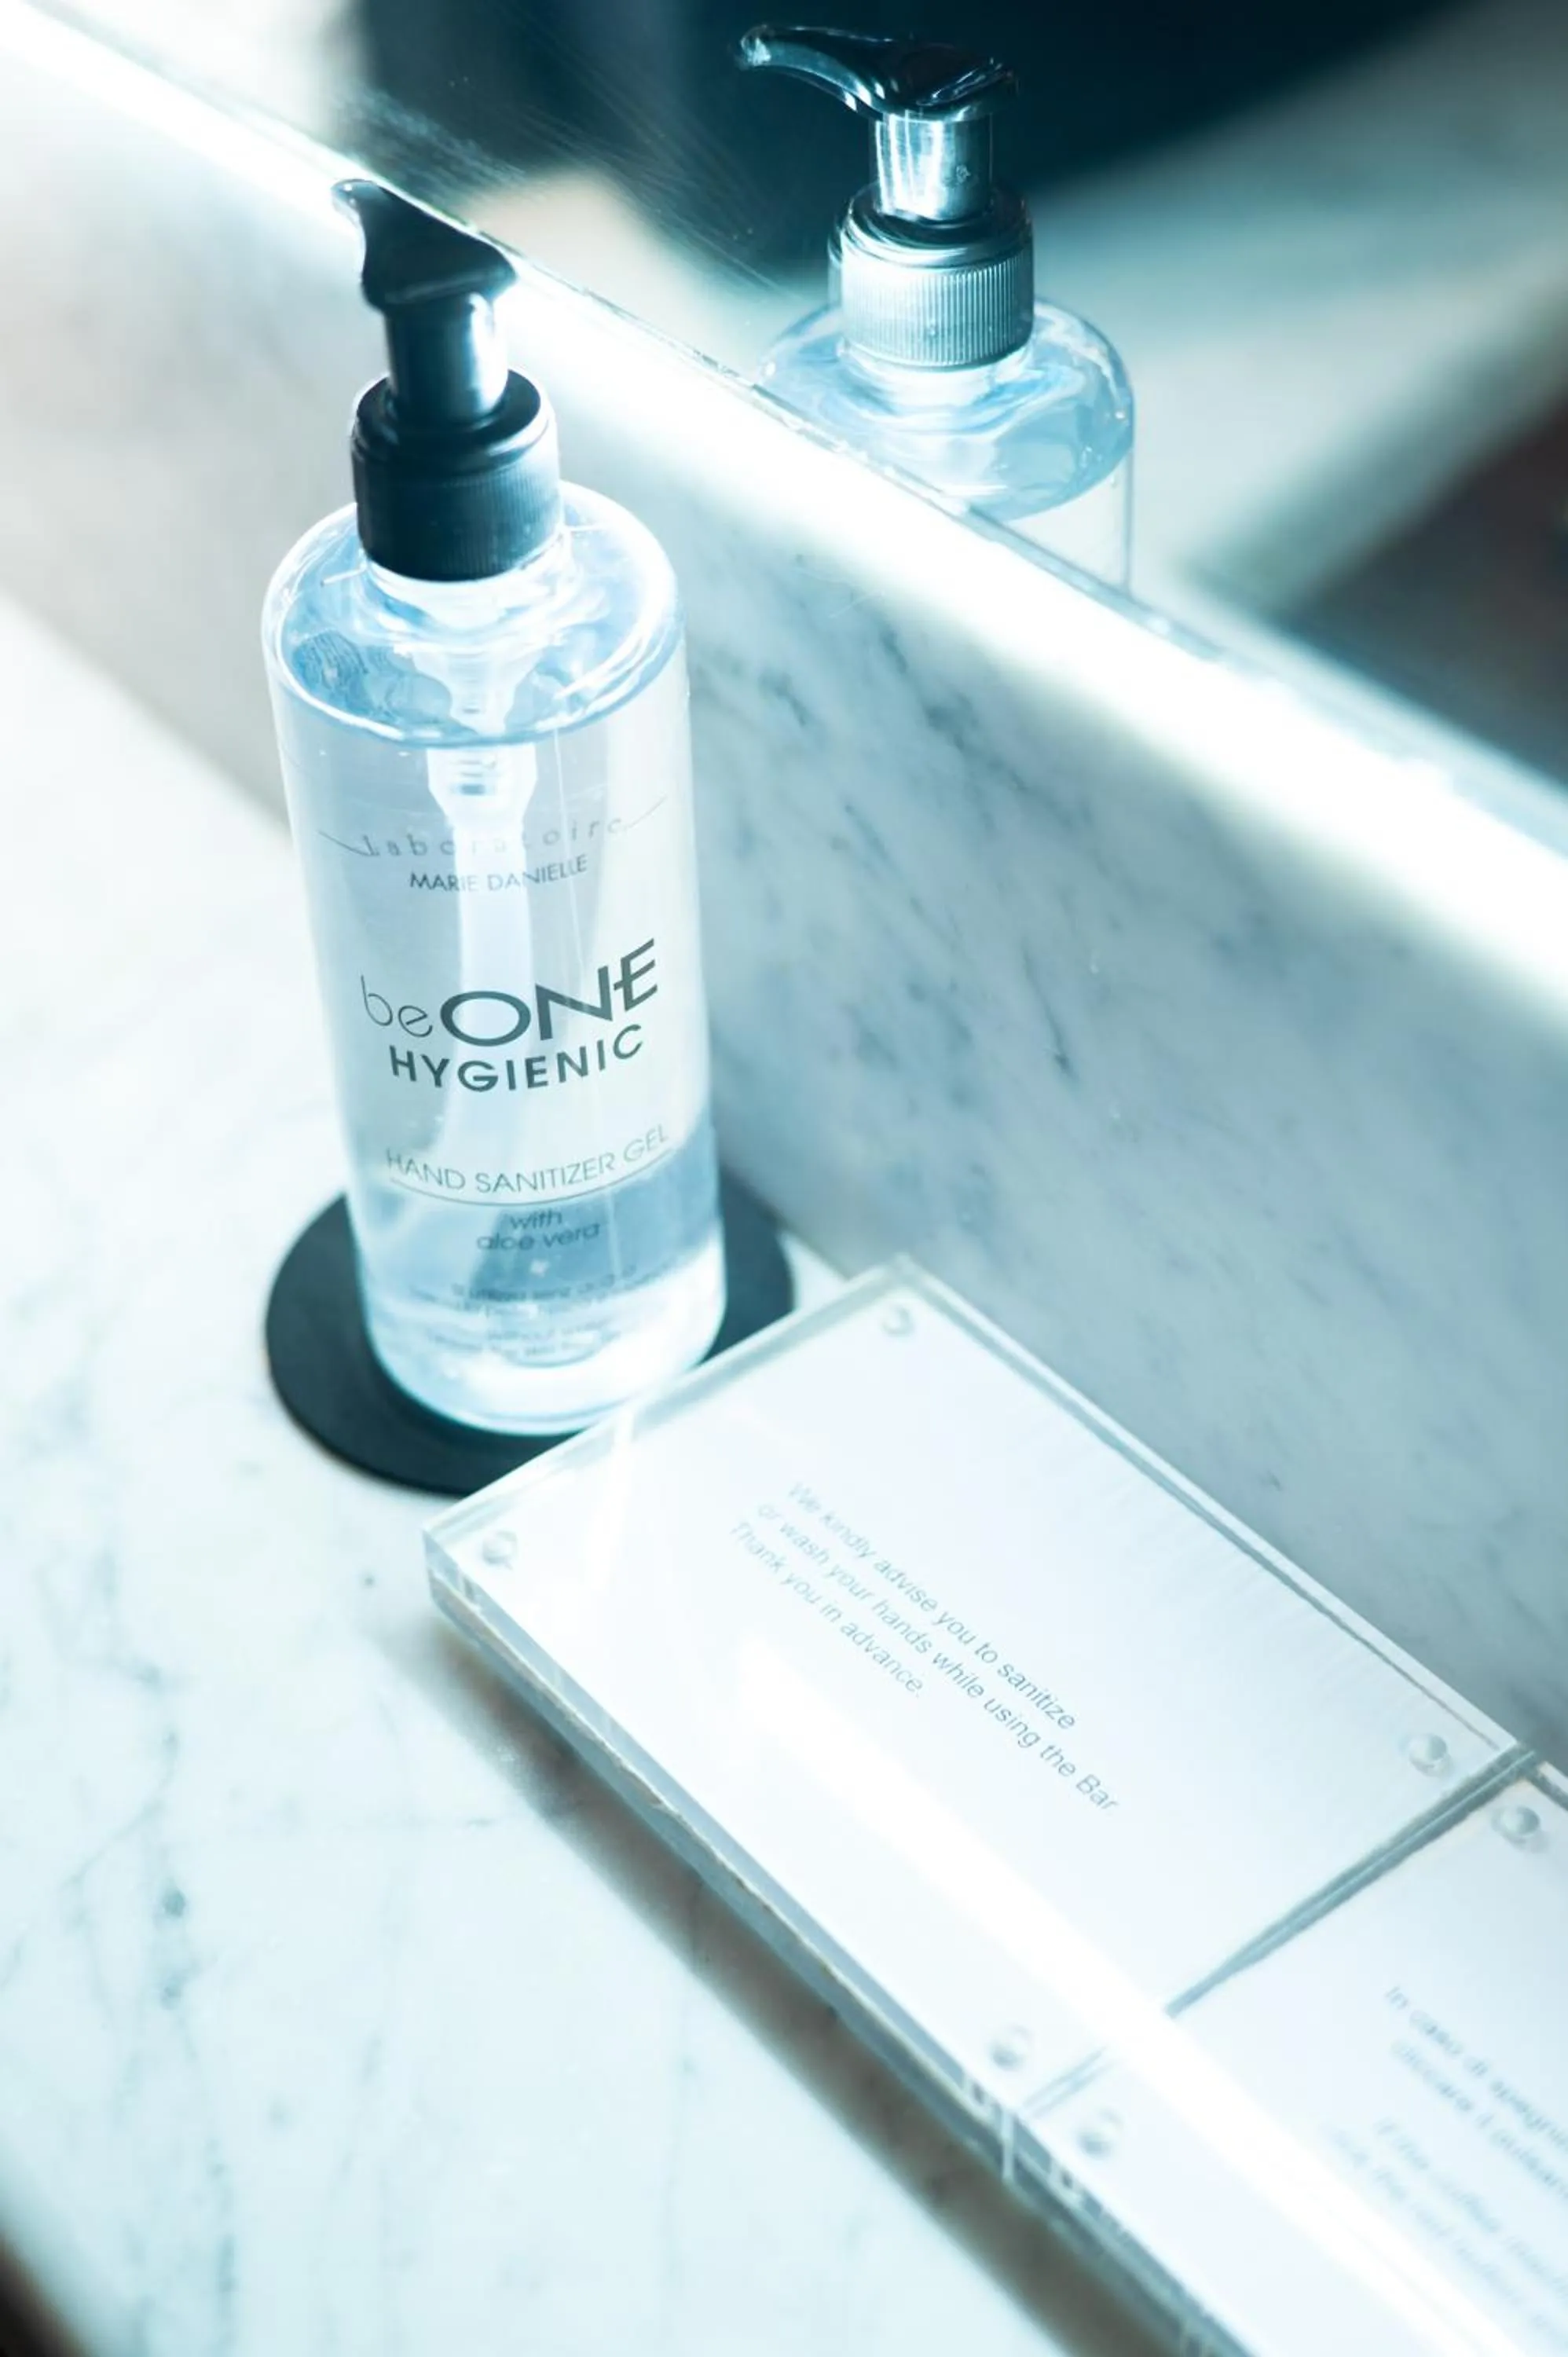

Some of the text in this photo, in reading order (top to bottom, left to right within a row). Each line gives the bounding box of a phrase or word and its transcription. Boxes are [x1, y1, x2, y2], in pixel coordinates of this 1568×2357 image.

[408, 853, 589, 892] MARIE DANIELLE
[389, 1024, 643, 1092] HYGIENIC
[385, 1124, 669, 1194] HAND SANITIZER GEL
[476, 1222, 602, 1251] aloe vera
[507, 1208, 562, 1230] with
[729, 1521, 786, 1574] Thank
[780, 1571, 823, 1606] you
[819, 1603, 843, 1624] in
[788, 1482, 1076, 1730] We kindly advise you to sanitize
[757, 1503, 781, 1521] or
[779, 1521, 830, 1567] wash
[825, 1563, 875, 1602] your
[870, 1598, 933, 1655] hands
[932, 1651, 985, 1699] while
[983, 1697, 1042, 1749] using
[1039, 1743, 1076, 1777] the
